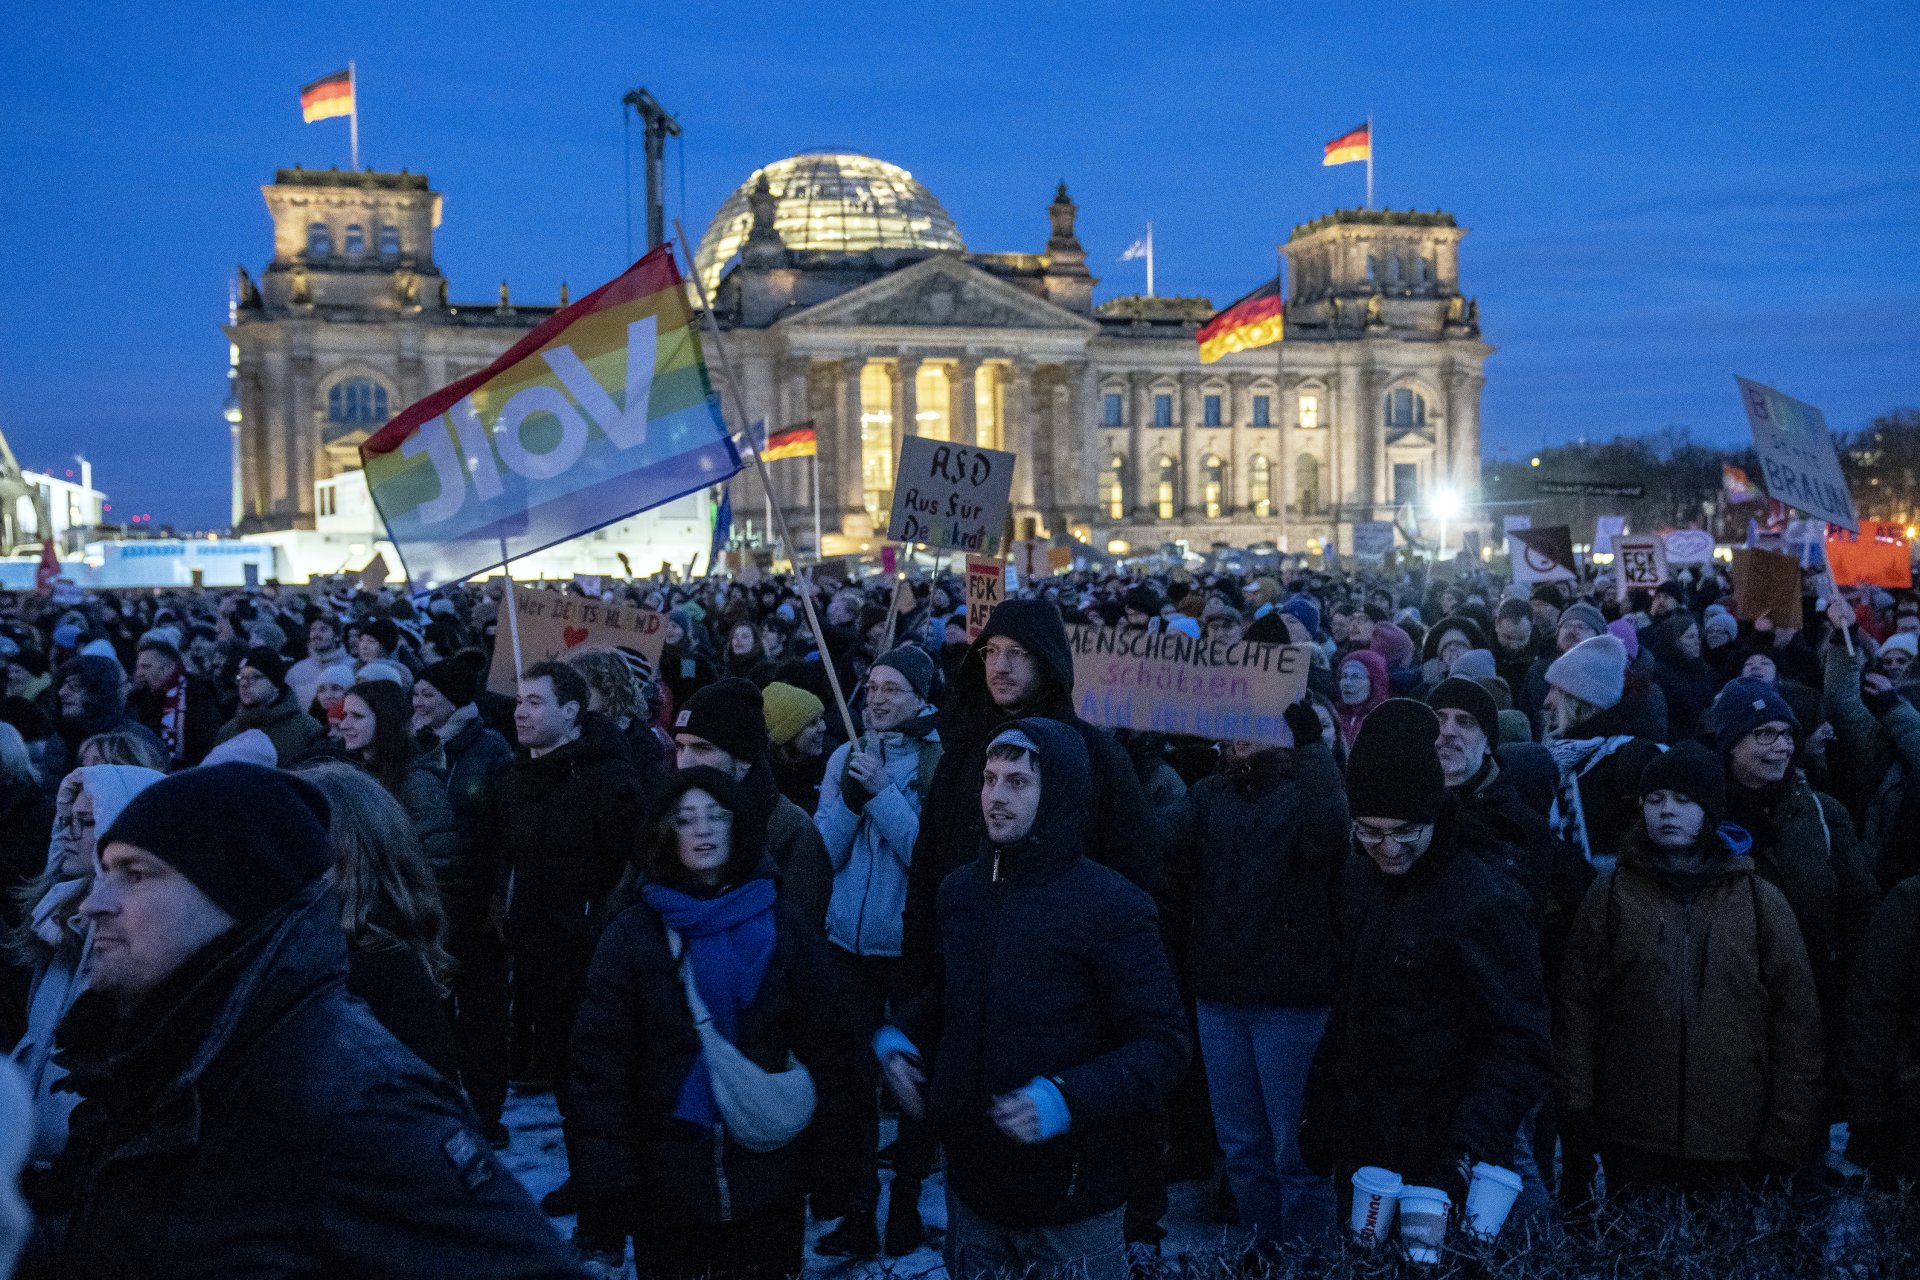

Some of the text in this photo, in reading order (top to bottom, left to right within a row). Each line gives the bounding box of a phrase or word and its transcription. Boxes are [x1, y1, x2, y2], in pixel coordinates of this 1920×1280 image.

[1748, 387, 1820, 441] BU
[904, 488, 983, 520] Aus für
[1764, 457, 1853, 520] BRAUN
[900, 515, 998, 551] Deokratie
[1622, 551, 1655, 567] FCK
[1625, 567, 1659, 583] NZS
[970, 575, 998, 601] FCK
[551, 598, 660, 635] DEUTSHLAND
[1068, 624, 1301, 674] MENSCHENRECHTE
